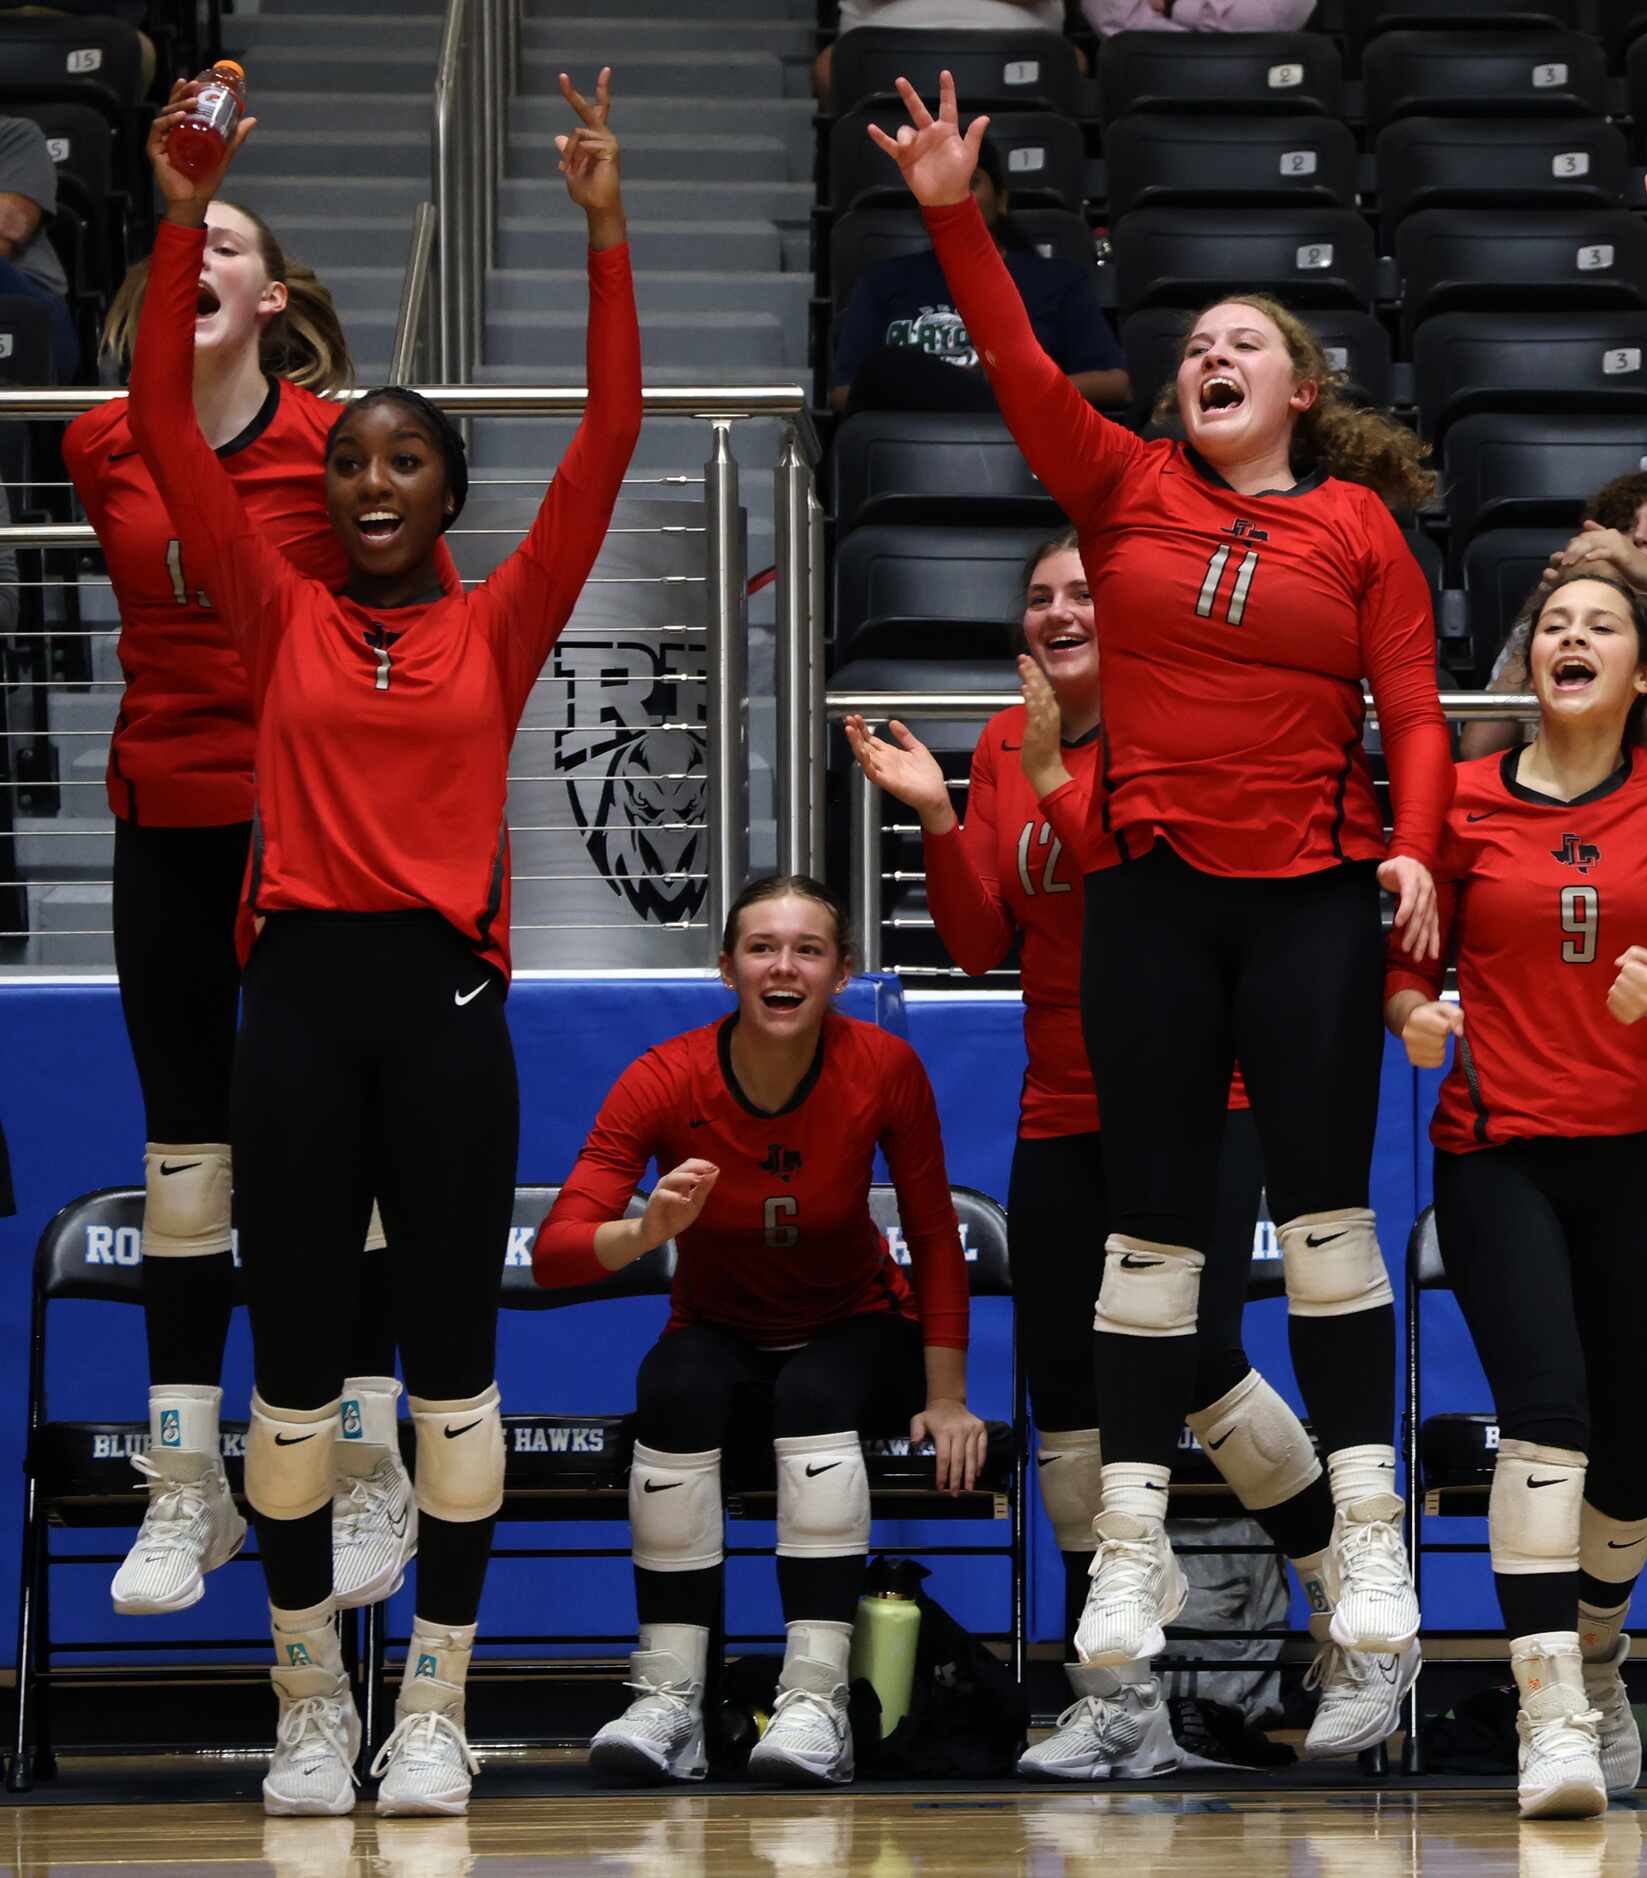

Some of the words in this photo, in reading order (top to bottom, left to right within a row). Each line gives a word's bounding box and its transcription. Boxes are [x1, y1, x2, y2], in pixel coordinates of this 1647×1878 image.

[75, 51, 95, 68] 15
[1018, 64, 1025, 78] 1
[1280, 67, 1292, 84] 2
[1545, 67, 1556, 83] 3
[1023, 150, 1030, 166] 1
[1292, 155, 1304, 171] 2
[1565, 156, 1577, 172] 3
[1589, 249, 1602, 265] 3
[887, 319, 971, 354] PLAYO
[1615, 352, 1628, 369] 3
[1195, 543, 1260, 627] 11
[373, 647, 391, 691] 1
[1016, 821, 1073, 897] 12
[1560, 885, 1599, 964] 9
[763, 1195, 799, 1248] 6
[85, 1225, 143, 1267] RO
[514, 1428, 604, 1453] HAWKS
